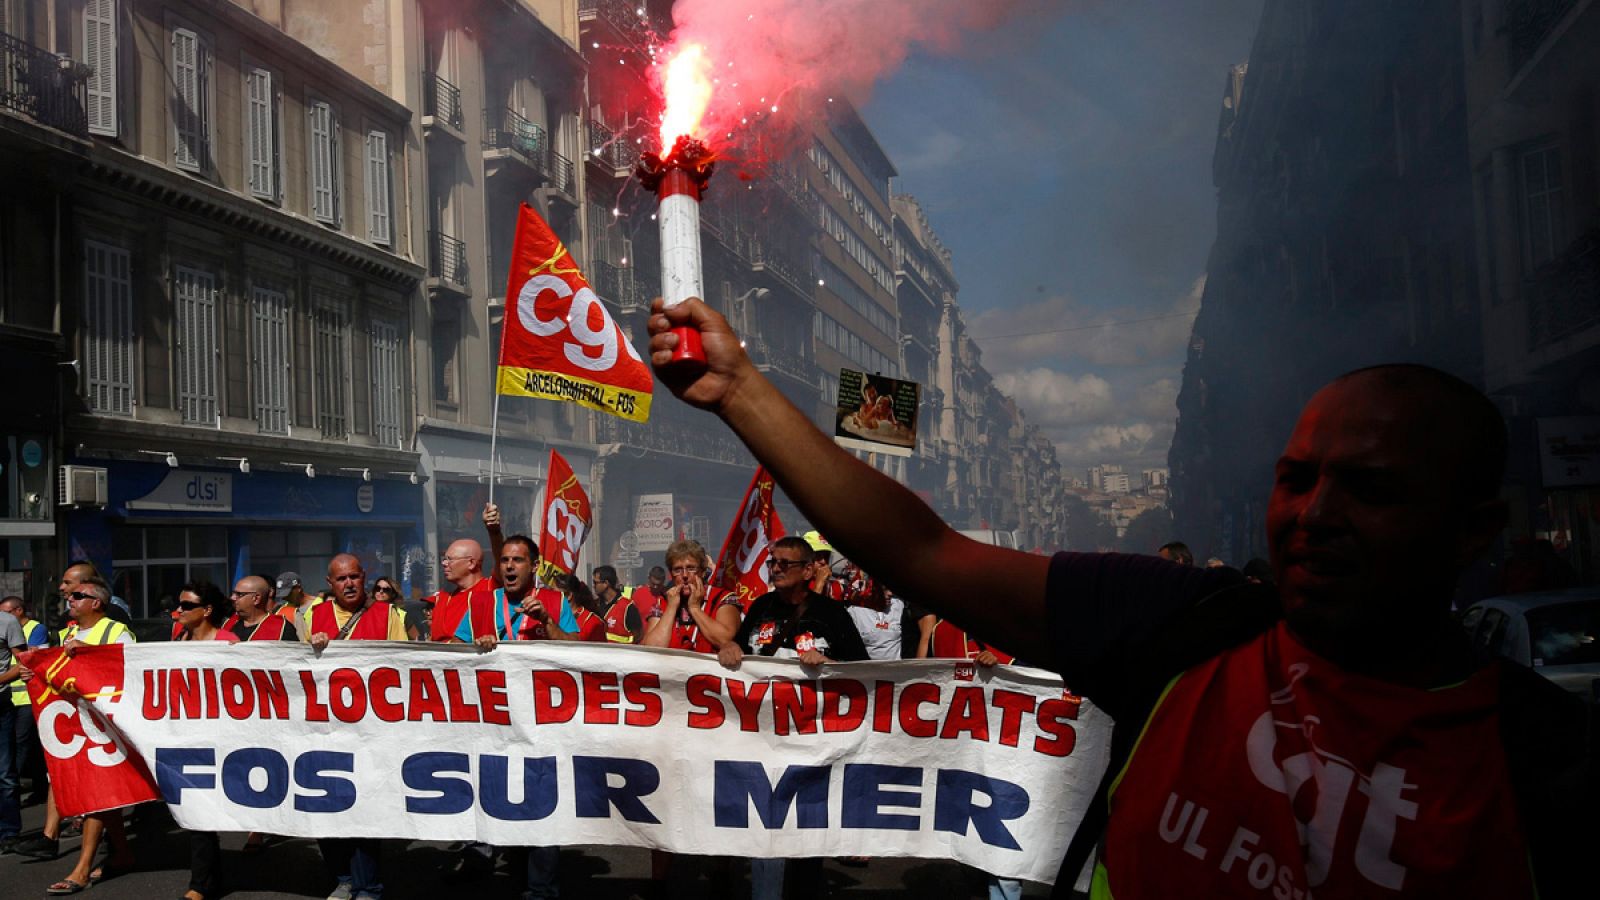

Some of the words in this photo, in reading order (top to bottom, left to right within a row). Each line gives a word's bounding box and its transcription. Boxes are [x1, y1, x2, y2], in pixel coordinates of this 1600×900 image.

[615, 391, 636, 415] FOS
[142, 667, 290, 721] UNION
[299, 666, 512, 726] LOCALE
[531, 668, 663, 728] DES
[685, 673, 1080, 758] SYNDICATS
[155, 747, 357, 813] FOS
[401, 751, 663, 825] SUR
[713, 760, 1031, 852] MER
[1158, 792, 1210, 862] UL
